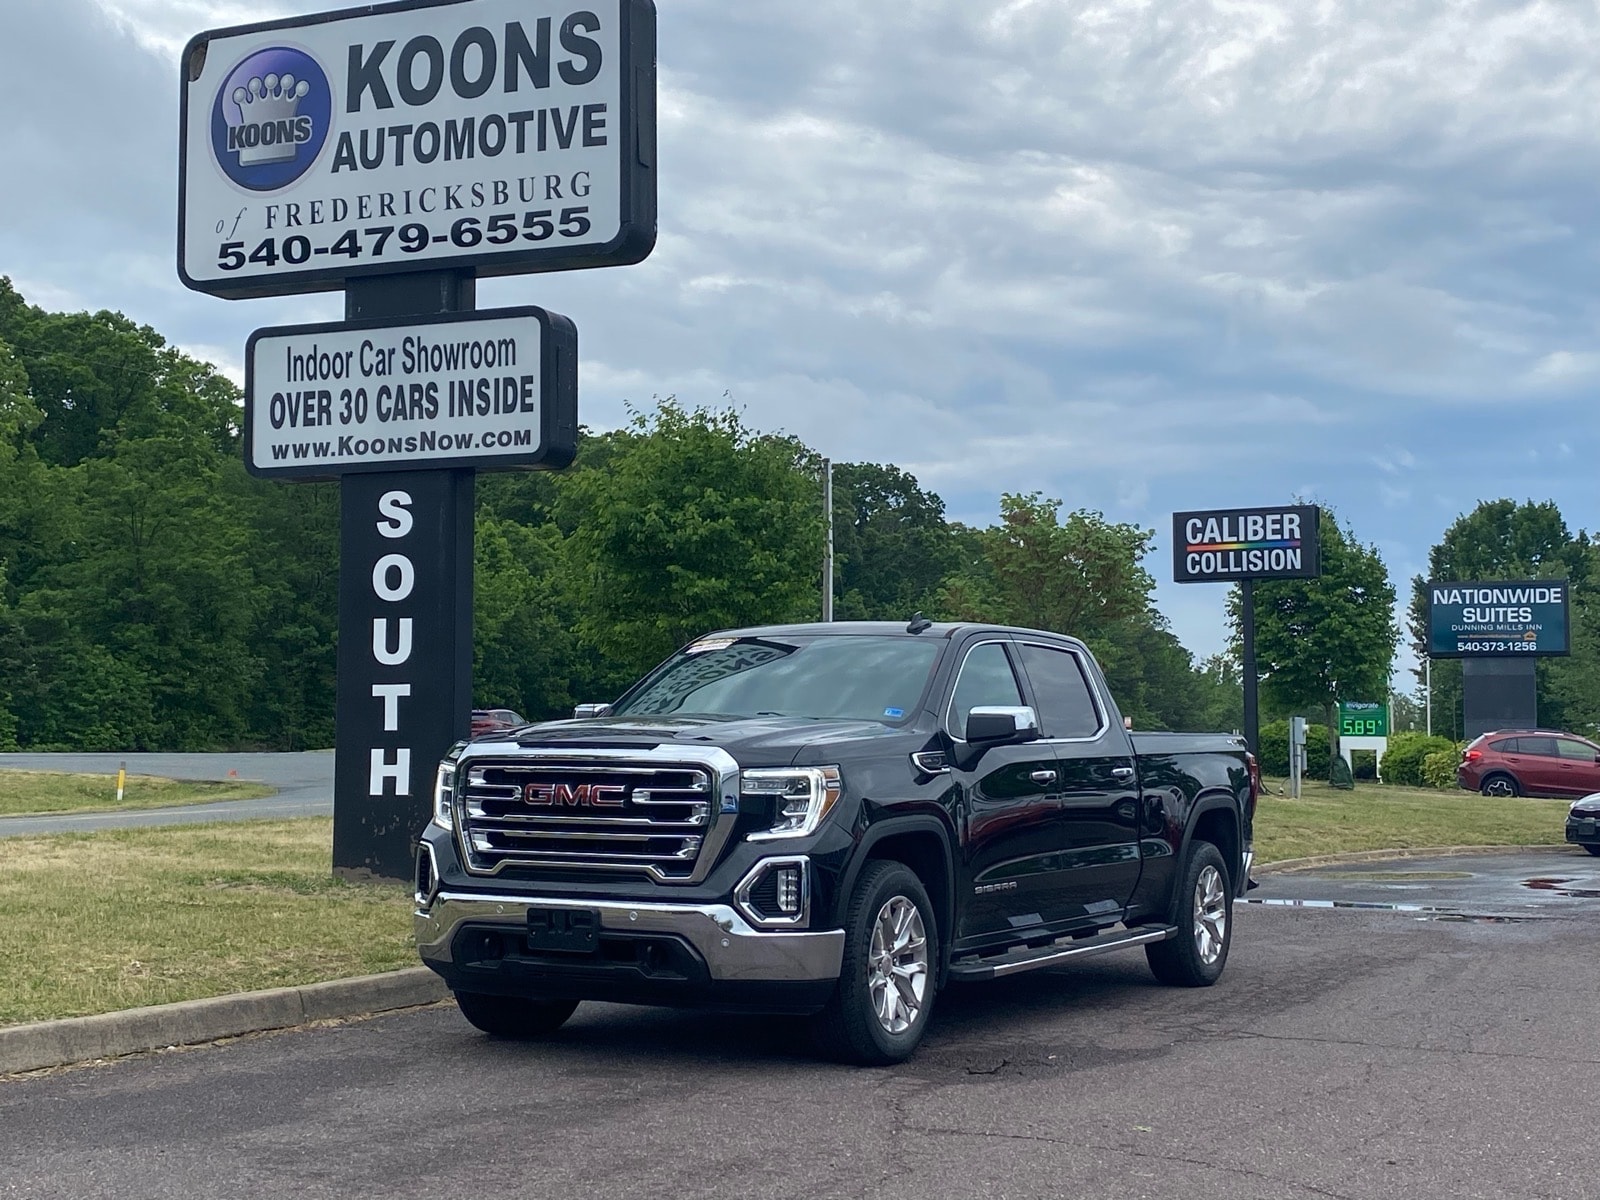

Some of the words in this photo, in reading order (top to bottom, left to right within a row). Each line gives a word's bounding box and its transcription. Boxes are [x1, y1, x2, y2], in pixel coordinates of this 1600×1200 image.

[346, 10, 602, 114] KOONS
[229, 117, 311, 150] KOONS
[331, 103, 608, 174] AUTOMOTIVE
[215, 207, 247, 241] of
[264, 170, 592, 230] FREDERICKSBURG
[217, 206, 591, 271] 540-479-6555
[286, 344, 353, 383] Indoor
[359, 339, 396, 377] Car
[402, 336, 516, 374] Showroom
[269, 389, 332, 430] OVER
[339, 388, 368, 425] 30
[376, 382, 439, 422] CARS
[449, 375, 534, 418] INSIDE
[1185, 513, 1301, 545] CALIBER
[1186, 548, 1302, 575] COLLISION
[1433, 588, 1562, 605] NATIONWIDE
[1462, 607, 1532, 623] SUITES
[369, 490, 415, 796] SOUTH
[1457, 642, 1537, 652] 540-373-1256
[524, 783, 626, 808] GMC
[974, 881, 1018, 895] SIERRA
